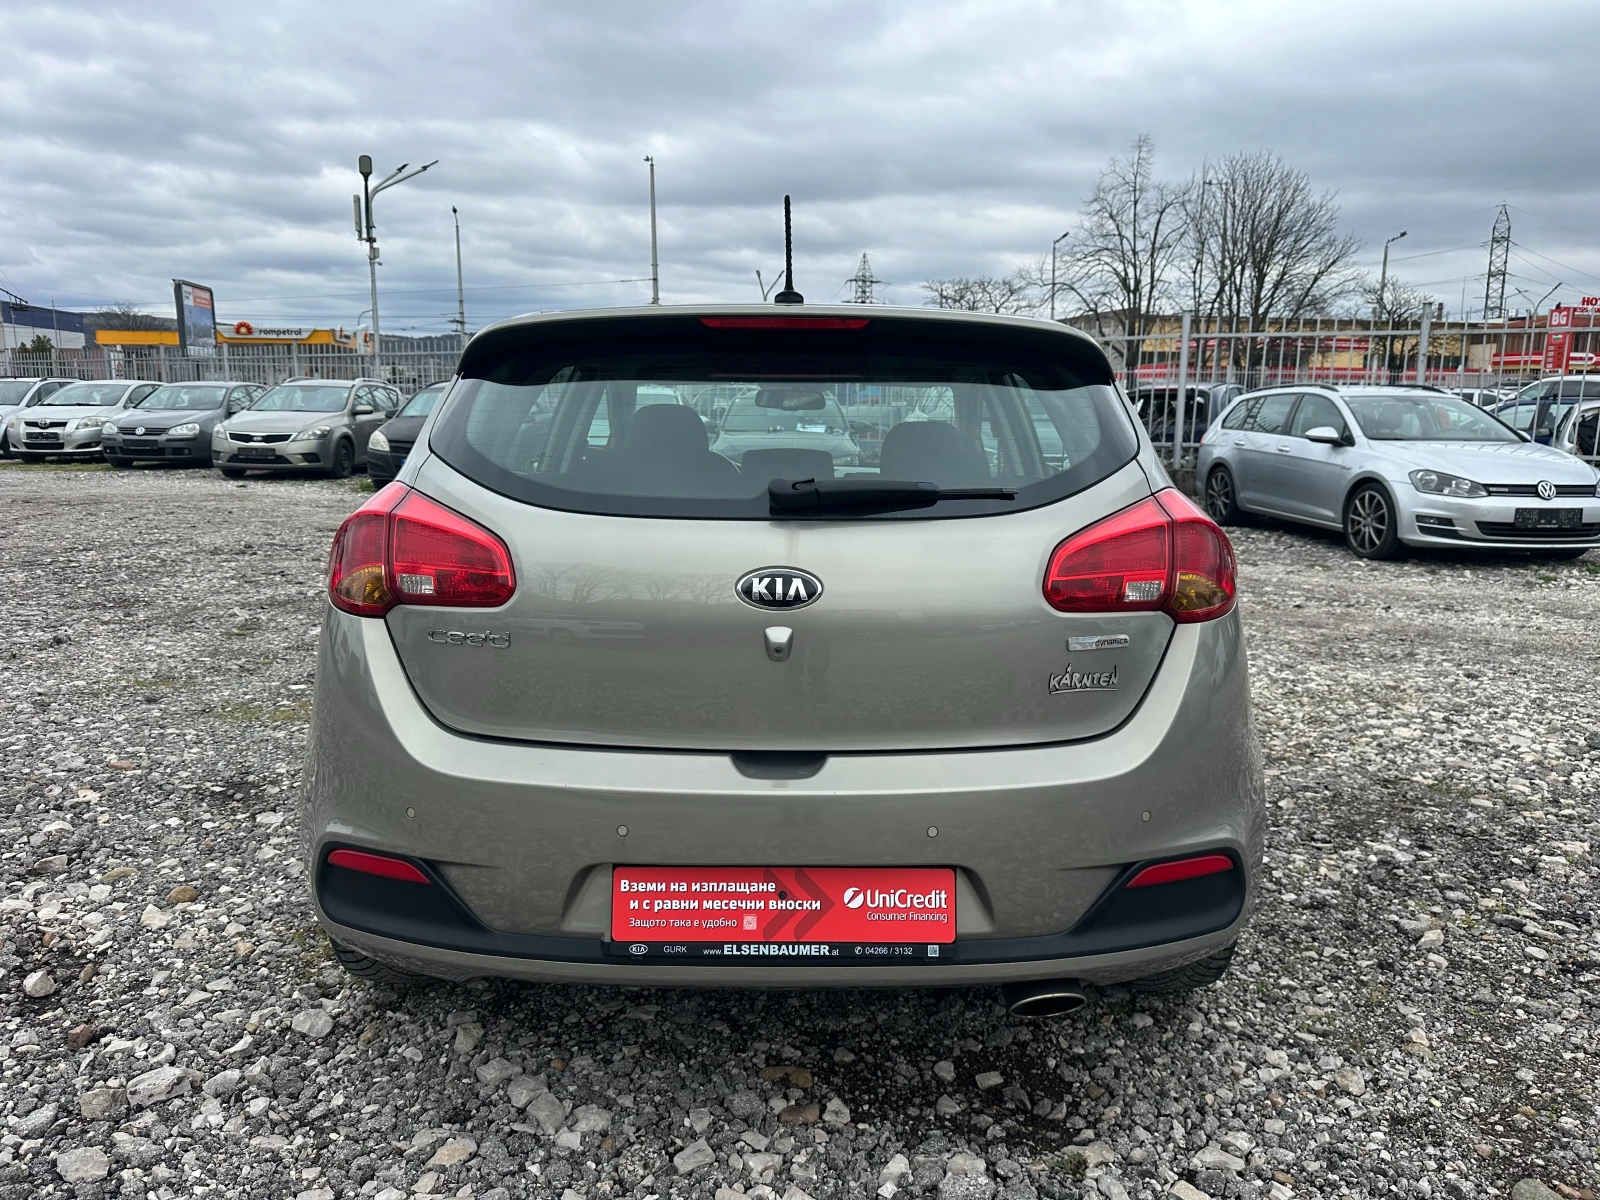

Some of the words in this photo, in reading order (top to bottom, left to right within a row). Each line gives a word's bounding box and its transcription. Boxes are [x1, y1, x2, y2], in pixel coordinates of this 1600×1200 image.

[1581, 296, 1600, 306] HO
[1551, 311, 1568, 325] BG
[259, 328, 302, 337] rompetrol
[751, 577, 809, 601] KIA
[1094, 638, 1129, 647] dynamics
[620, 879, 666, 893] Вземи
[670, 882, 688, 893] на
[691, 882, 776, 895] изплащане
[866, 888, 948, 909] UniCredit
[629, 899, 639, 911] и
[642, 899, 651, 911] с
[654, 899, 699, 913] равни
[702, 899, 765, 911] месечни
[768, 899, 822, 912] вноски
[629, 917, 667, 928] Защото
[669, 919, 692, 927] така
[693, 919, 700, 927] е
[702, 917, 738, 929] удобно
[866, 911, 908, 921] Consumer
[909, 911, 948, 924] Financing
[663, 945, 688, 953] GURK
[702, 944, 839, 956] www.ELSENBAUMER.at
[865, 946, 888, 955] 04266
[894, 946, 913, 955] 3132
